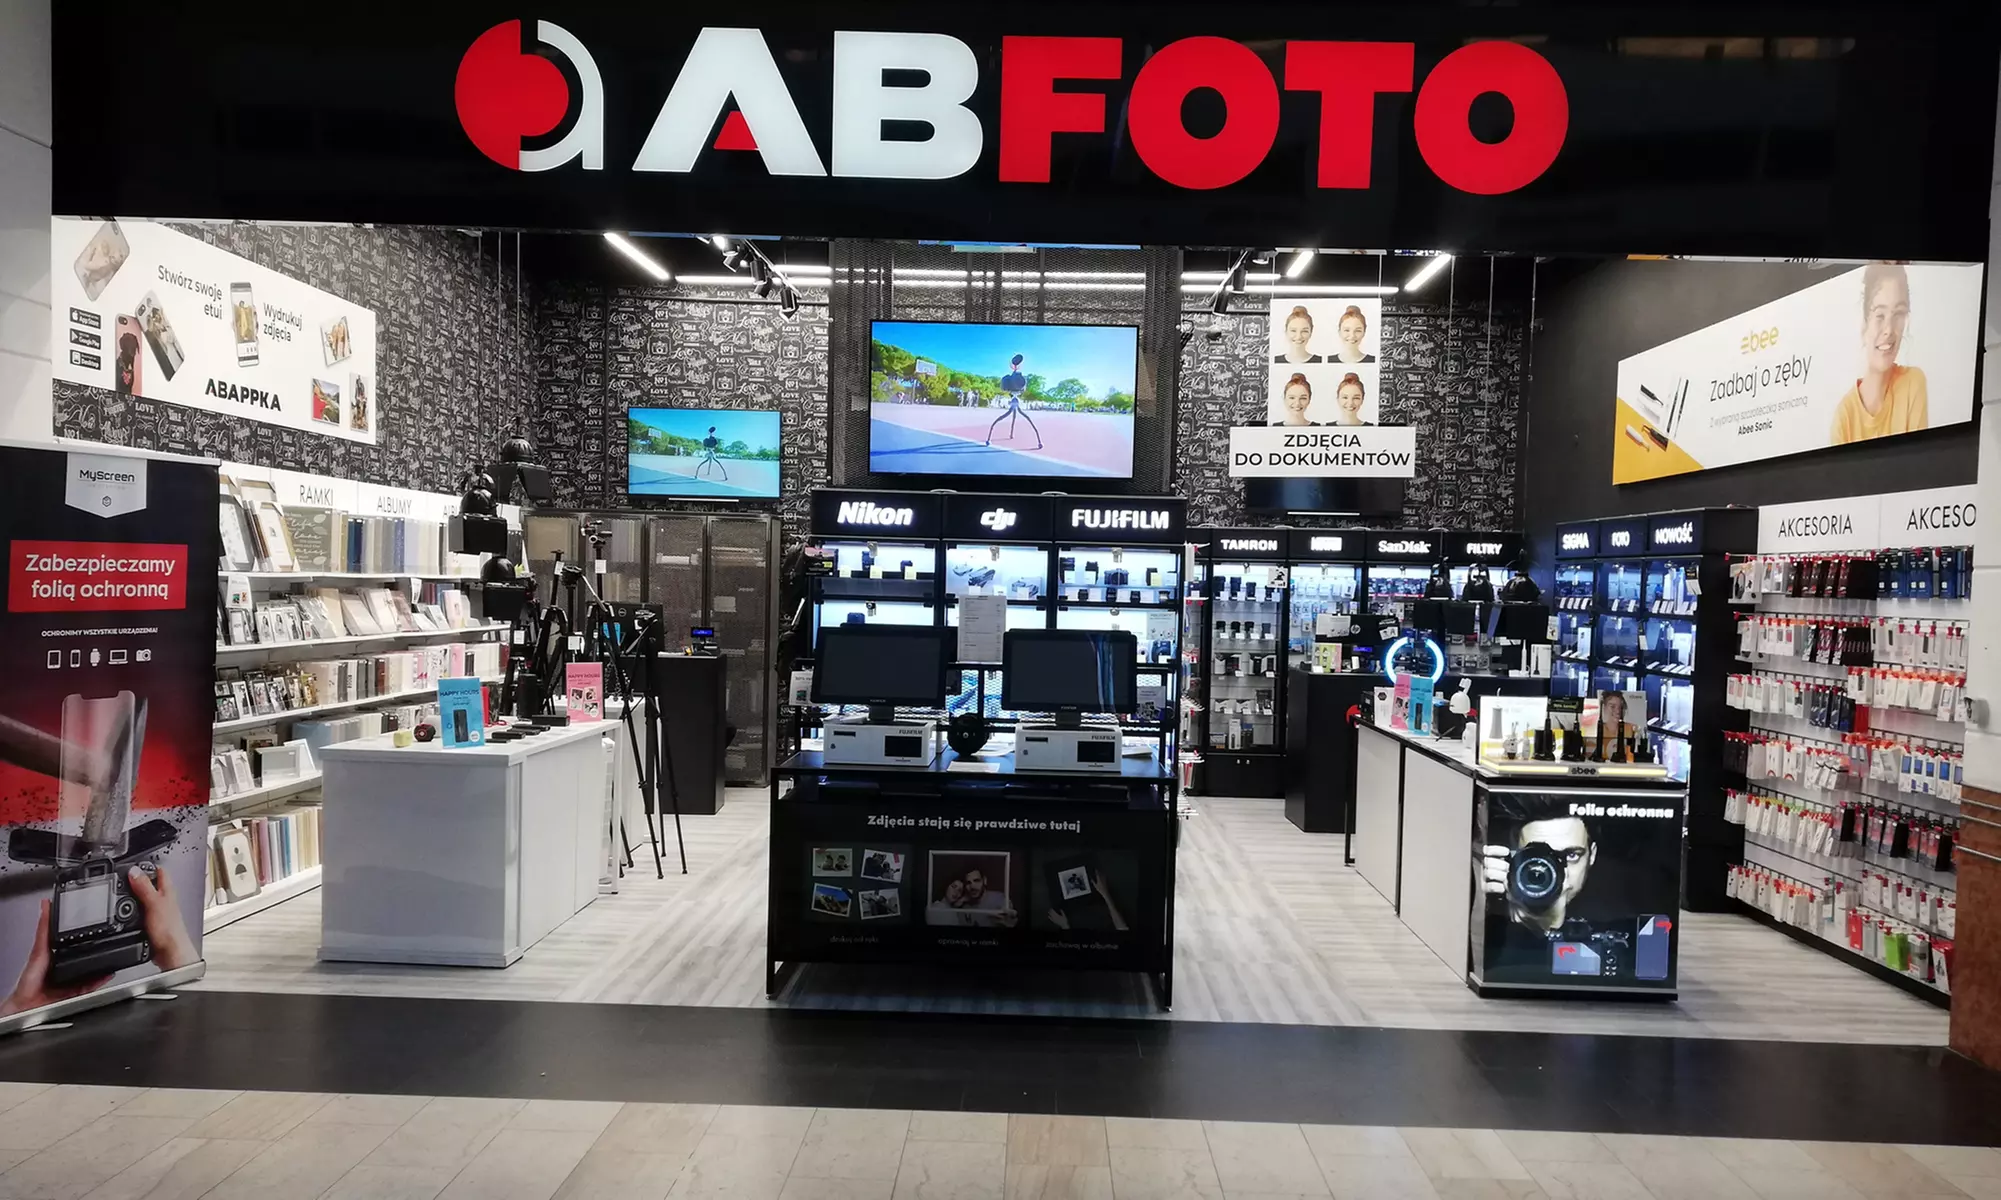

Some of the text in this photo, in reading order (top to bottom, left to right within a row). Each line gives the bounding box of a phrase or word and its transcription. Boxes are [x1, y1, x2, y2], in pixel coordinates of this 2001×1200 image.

[157, 264, 223, 303] Stwórz swoje
[203, 301, 223, 321] etui
[262, 302, 303, 332] Wydrukuj
[262, 322, 292, 345] zdjęcia
[1710, 354, 1812, 402] Zadbaj o zęby
[204, 378, 282, 412] ABAPPKA
[1738, 418, 1773, 436] Abee Sonic
[1283, 433, 1361, 452] ZDJĘCIA
[1235, 449, 1411, 468] DO DOKUMENTÓW
[78, 469, 136, 483] MyScreen
[300, 485, 334, 506] RAMKI
[377, 496, 412, 514] ALBUMY
[837, 501, 913, 526] Nikon
[1071, 508, 1169, 530] FUJIFILM
[1655, 521, 1693, 545] NOWOŚĆ
[1778, 513, 1853, 539] AKCESORIA
[1220, 539, 1278, 552] TAMRON
[1378, 540, 1432, 555] SanDisk
[1466, 543, 1503, 556] FILTRY
[1562, 532, 1590, 550] SIGMA
[25, 553, 176, 576] Zabezpieczamy
[31, 579, 169, 601] folią ochronną
[41, 629, 82, 638] OCHRONIMY
[83, 628, 118, 636] WSZYSTKIE
[1569, 803, 1674, 819] Folia ochronna
[867, 815, 1081, 834] Zdjęcia stają się prawdziwe tutaj
